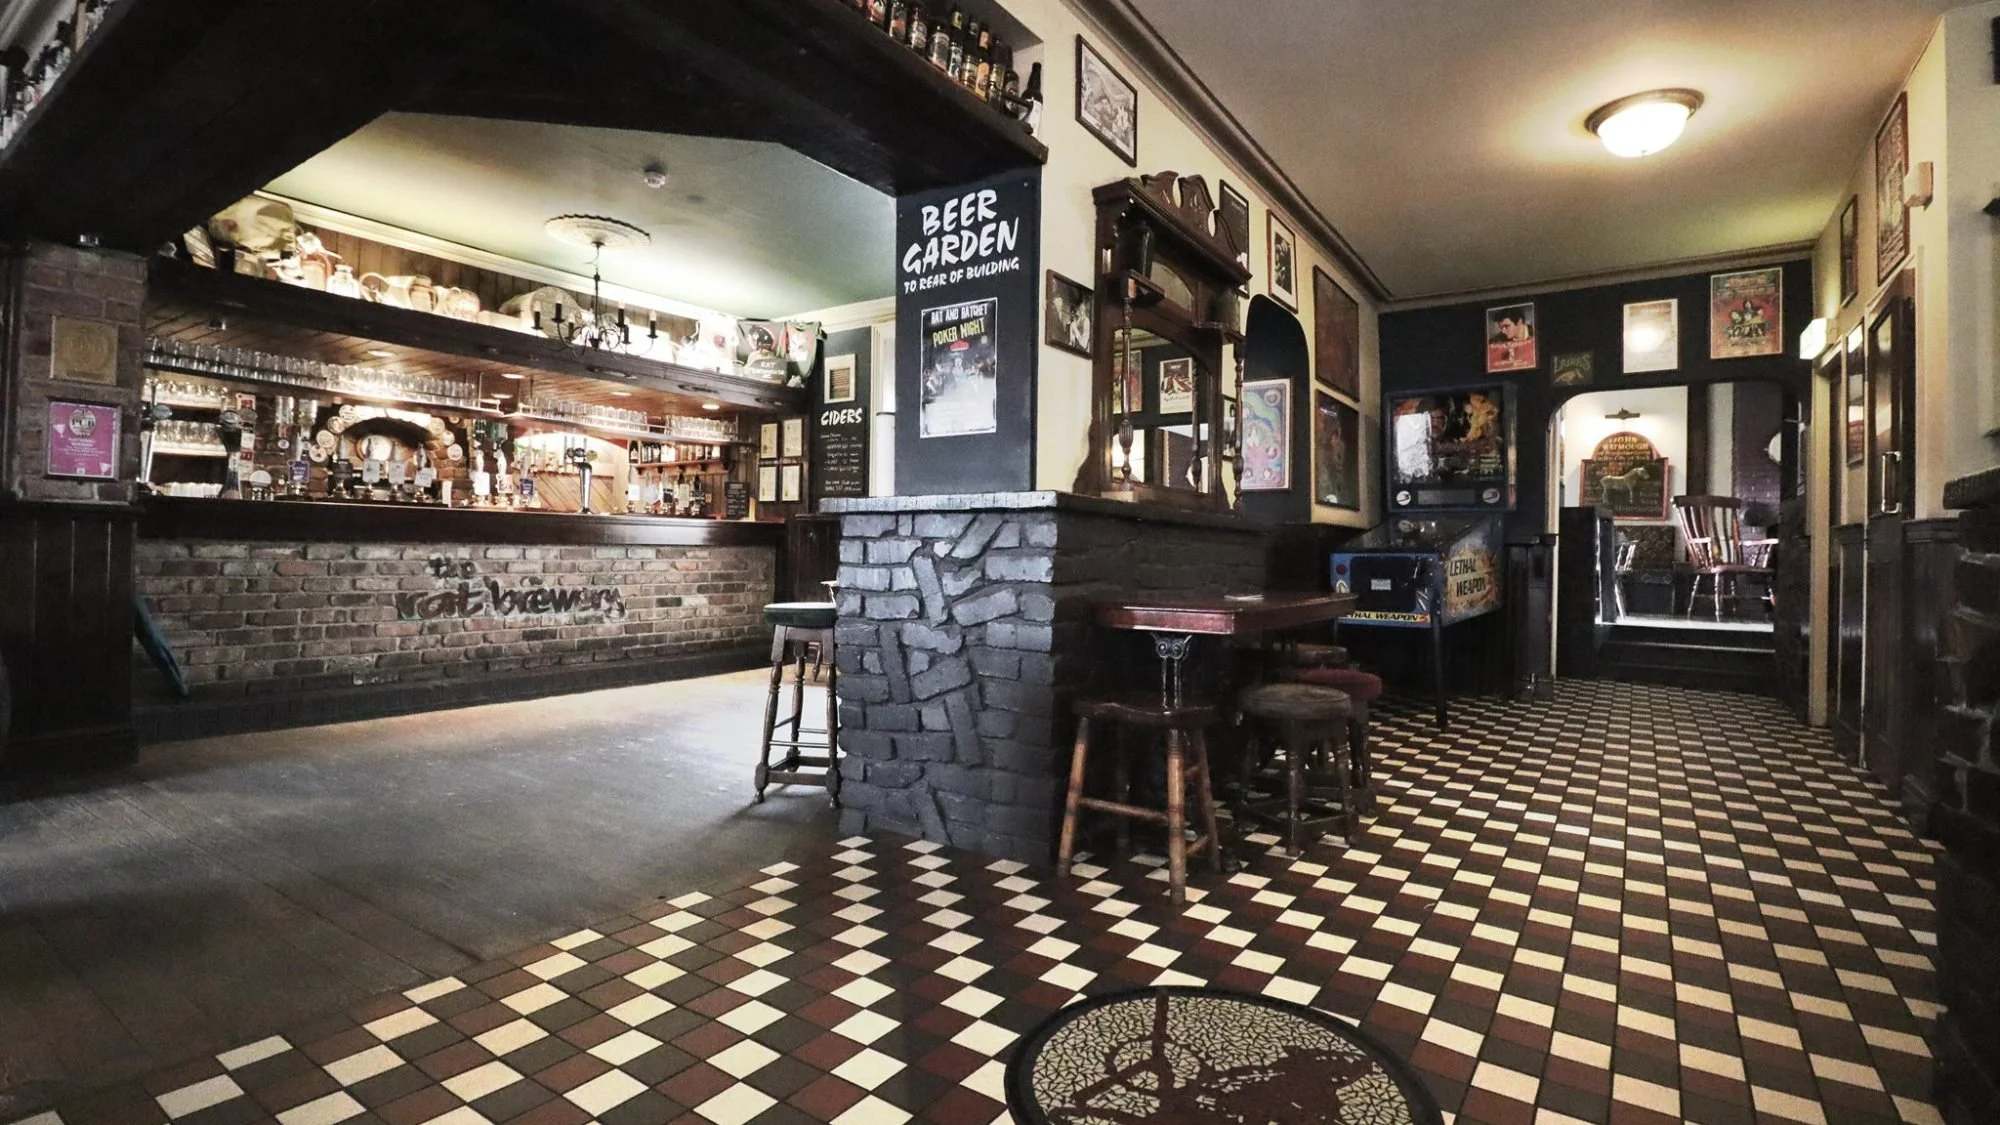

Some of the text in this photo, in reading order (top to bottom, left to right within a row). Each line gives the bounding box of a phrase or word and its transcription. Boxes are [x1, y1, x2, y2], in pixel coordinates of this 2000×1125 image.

[921, 189, 997, 236] BEER
[902, 217, 1019, 275] GARDEN
[903, 257, 1020, 294] TO REAR OF BUILDING
[945, 308, 959, 322] AND
[932, 317, 985, 348] POKER NIGHT
[820, 408, 863, 426] CIDERS
[1449, 558, 1477, 577] LETHAL
[396, 582, 484, 618] rat
[1456, 577, 1486, 598] WEAPON
[1375, 612, 1418, 621] WEAPON
